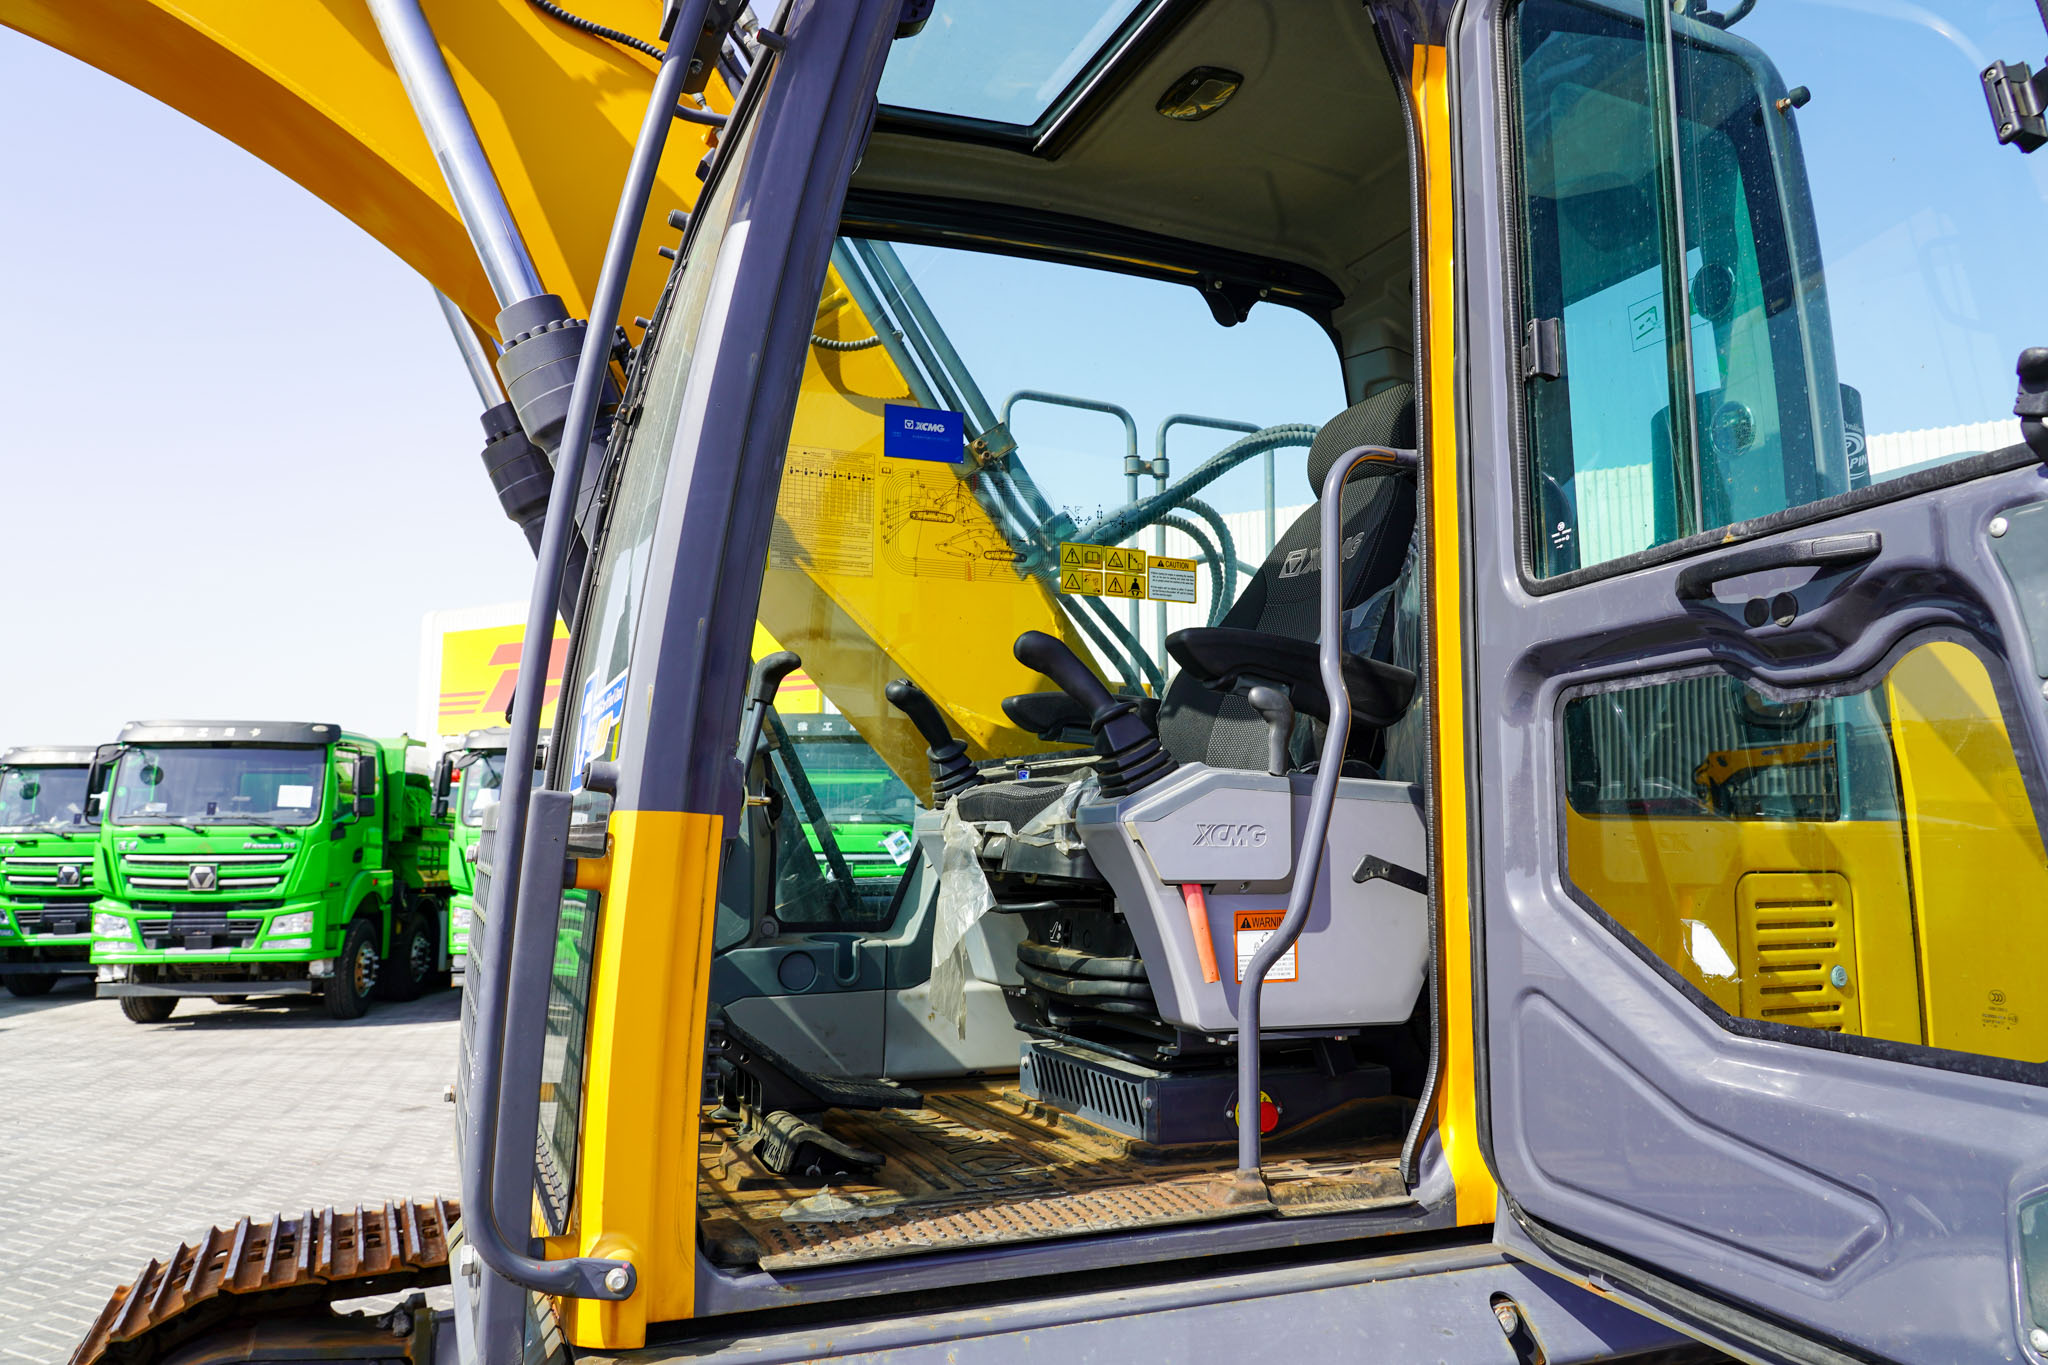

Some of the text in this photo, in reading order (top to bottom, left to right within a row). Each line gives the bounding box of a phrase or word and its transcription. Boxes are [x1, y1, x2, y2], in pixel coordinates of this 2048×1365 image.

[914, 421, 945, 433] XCMG
[1165, 560, 1189, 569] CAUTION
[1192, 823, 1268, 848] XCMG
[1251, 916, 1285, 929] WARNIN
